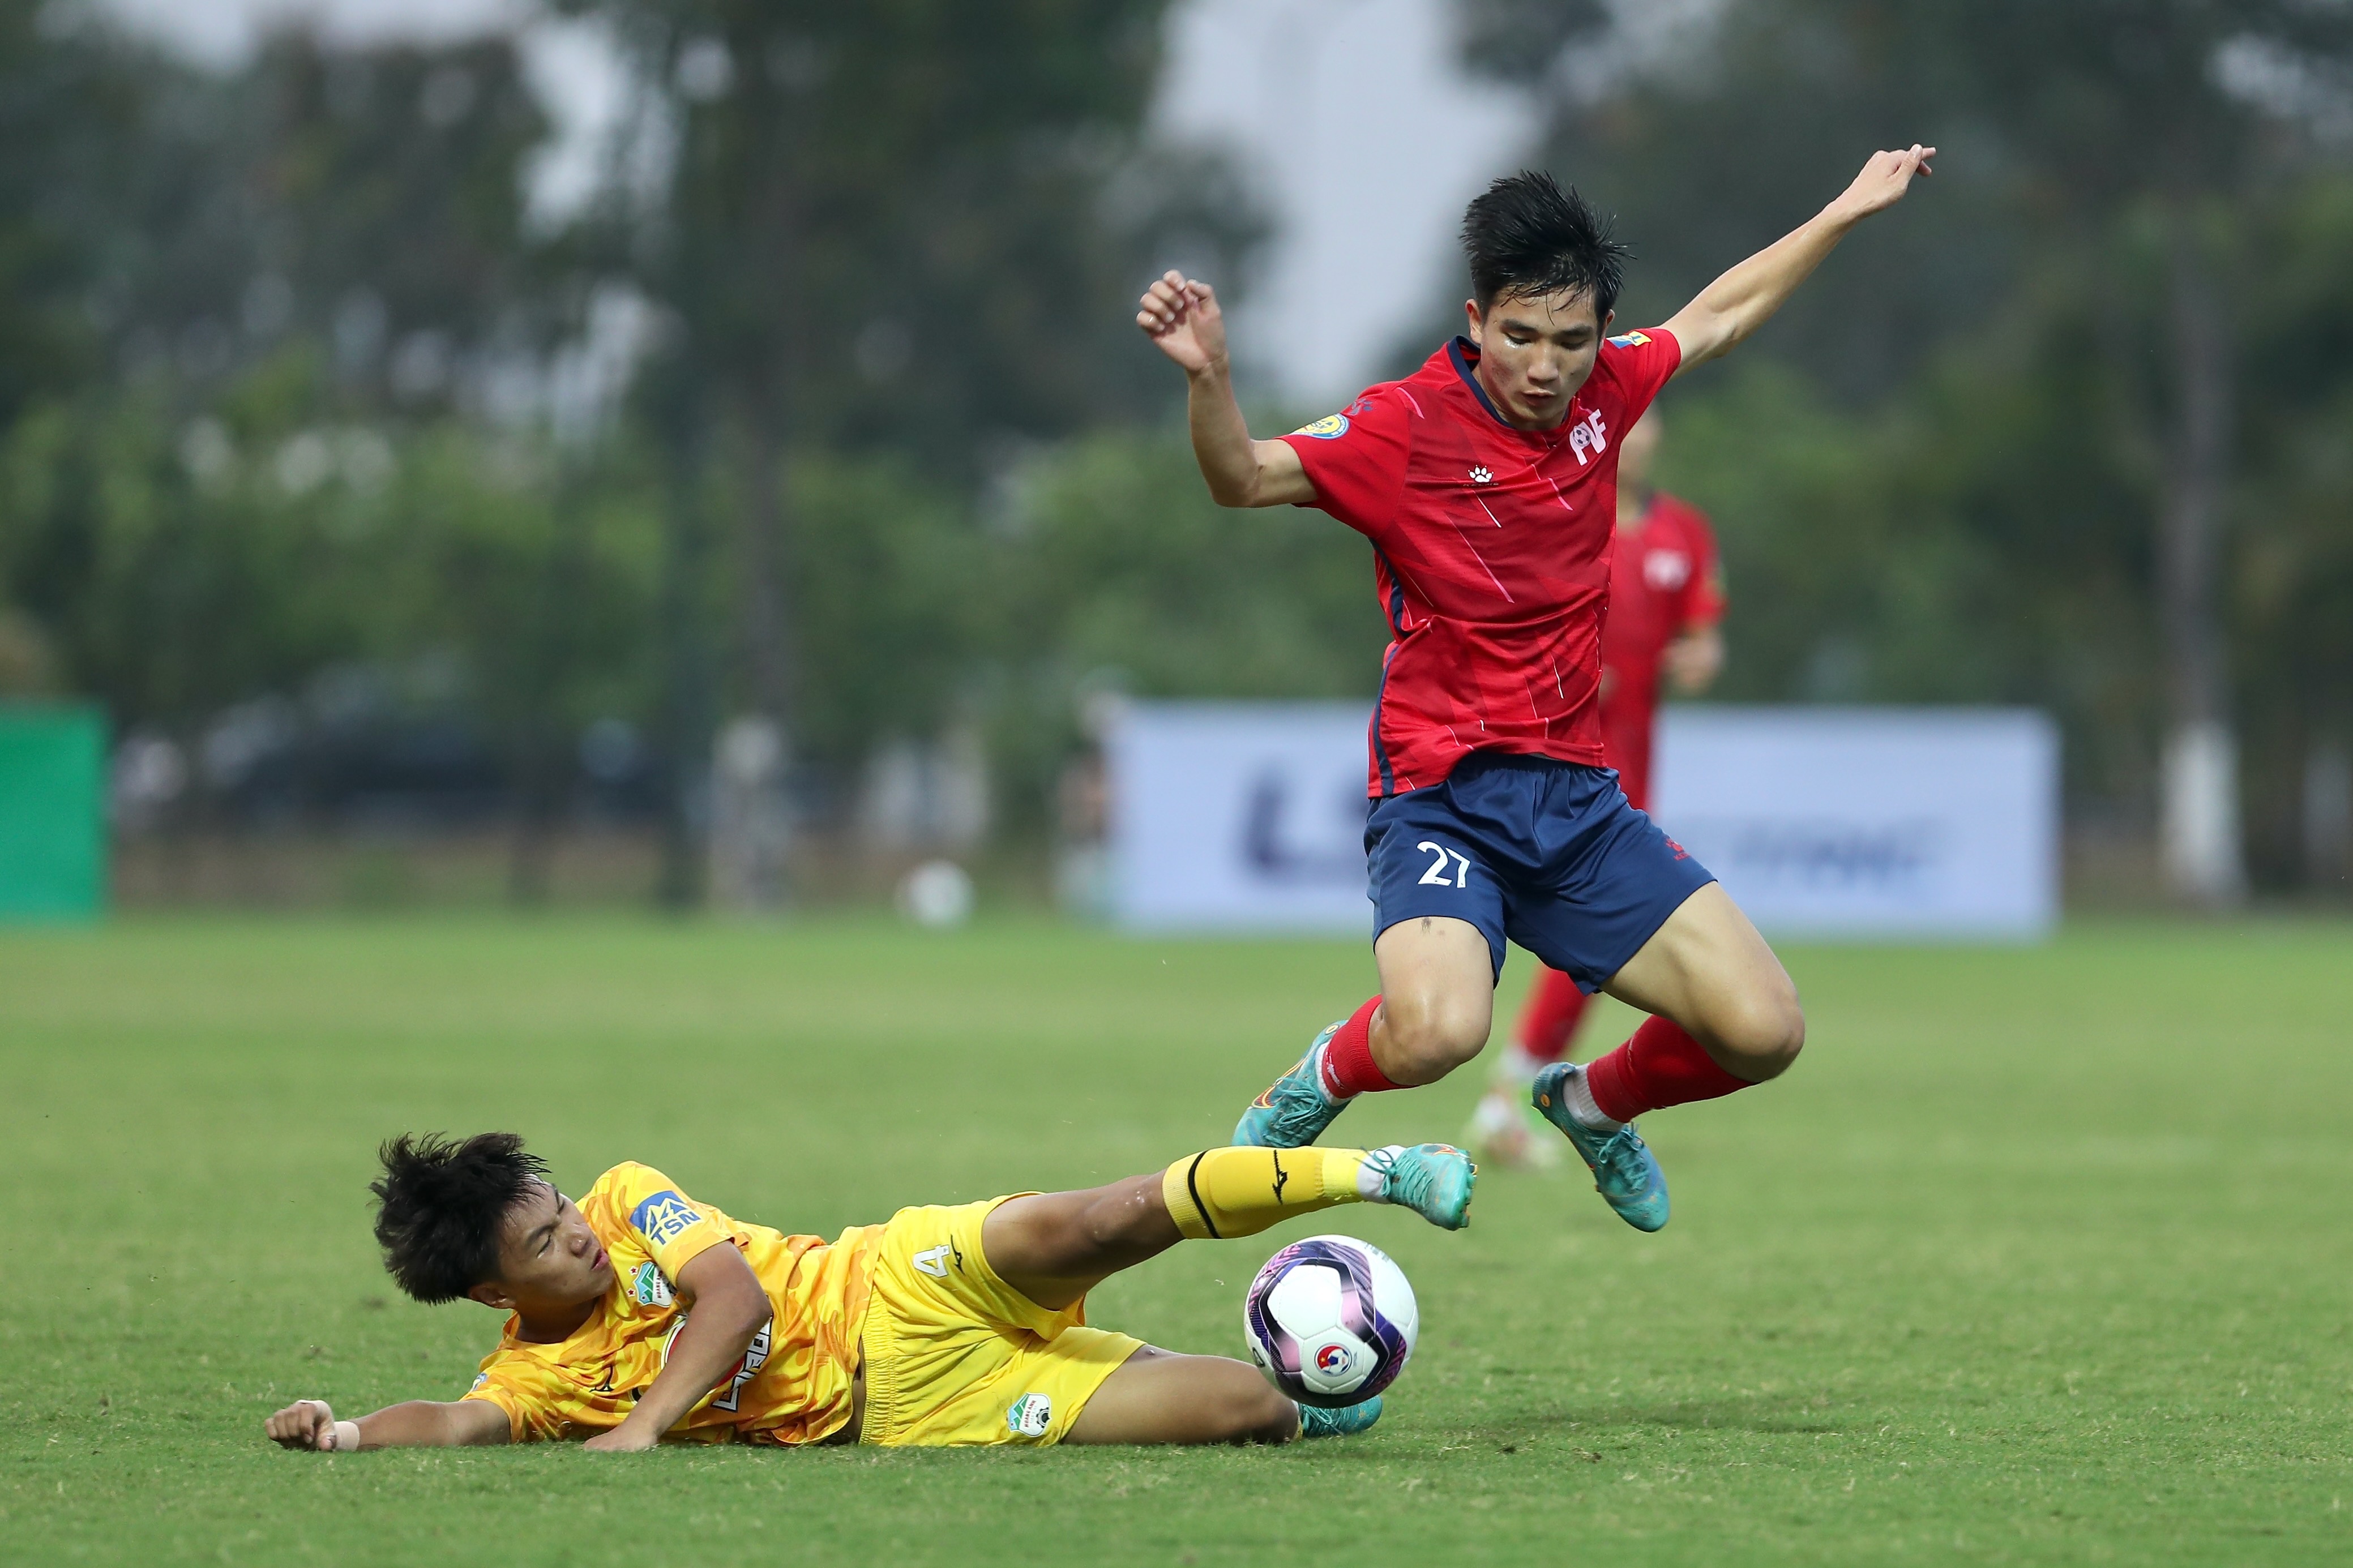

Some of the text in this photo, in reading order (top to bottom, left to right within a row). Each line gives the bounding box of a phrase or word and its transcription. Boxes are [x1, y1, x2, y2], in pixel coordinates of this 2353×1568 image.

[1417, 841, 1471, 888] 27
[651, 1211, 701, 1245] TSN
[913, 1244, 950, 1278] 4
